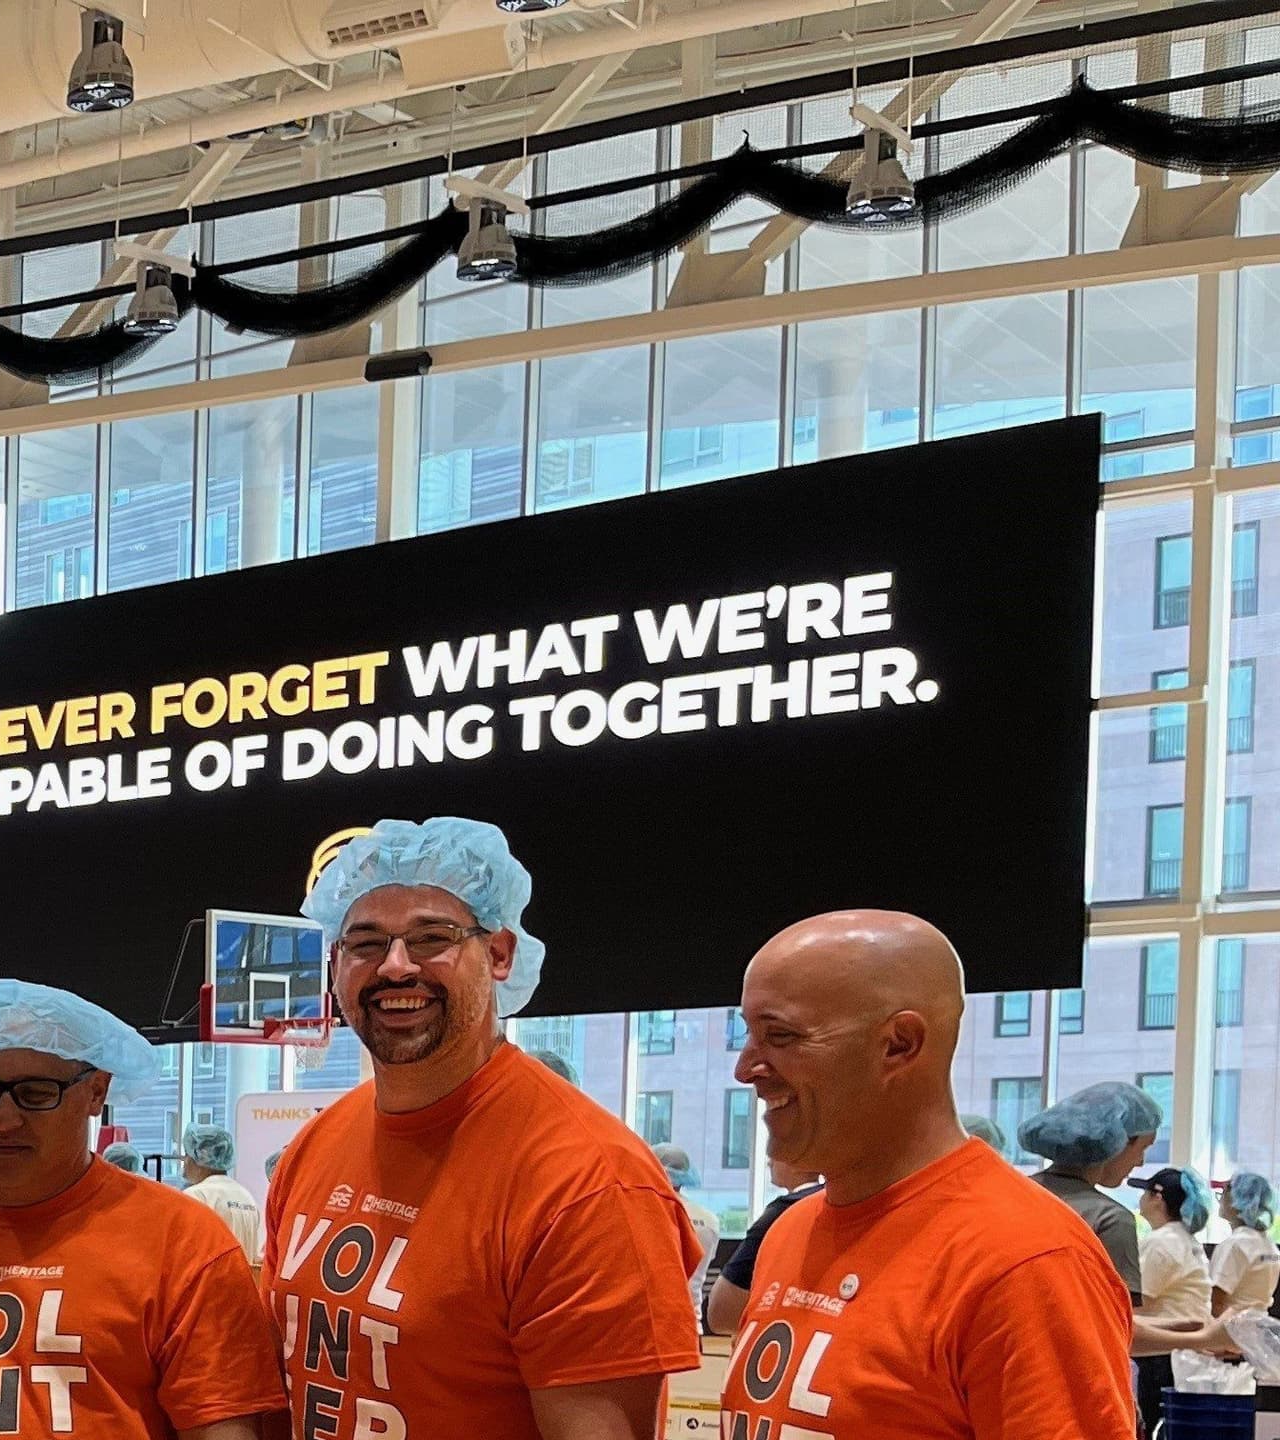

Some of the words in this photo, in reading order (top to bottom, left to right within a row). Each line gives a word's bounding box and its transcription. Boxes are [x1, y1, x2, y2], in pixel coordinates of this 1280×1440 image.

[150, 650, 390, 735] FORGET
[402, 613, 619, 698] WHAT
[633, 571, 894, 665] WE'RE
[183, 734, 269, 793] OF
[282, 703, 494, 783] DOING
[508, 645, 940, 753] TOGETHER.
[252, 1108, 310, 1119] THANKS
[373, 1196, 420, 1219] HERITAGE
[4, 1266, 65, 1278] HERITAGE
[280, 1213, 409, 1312] VOL
